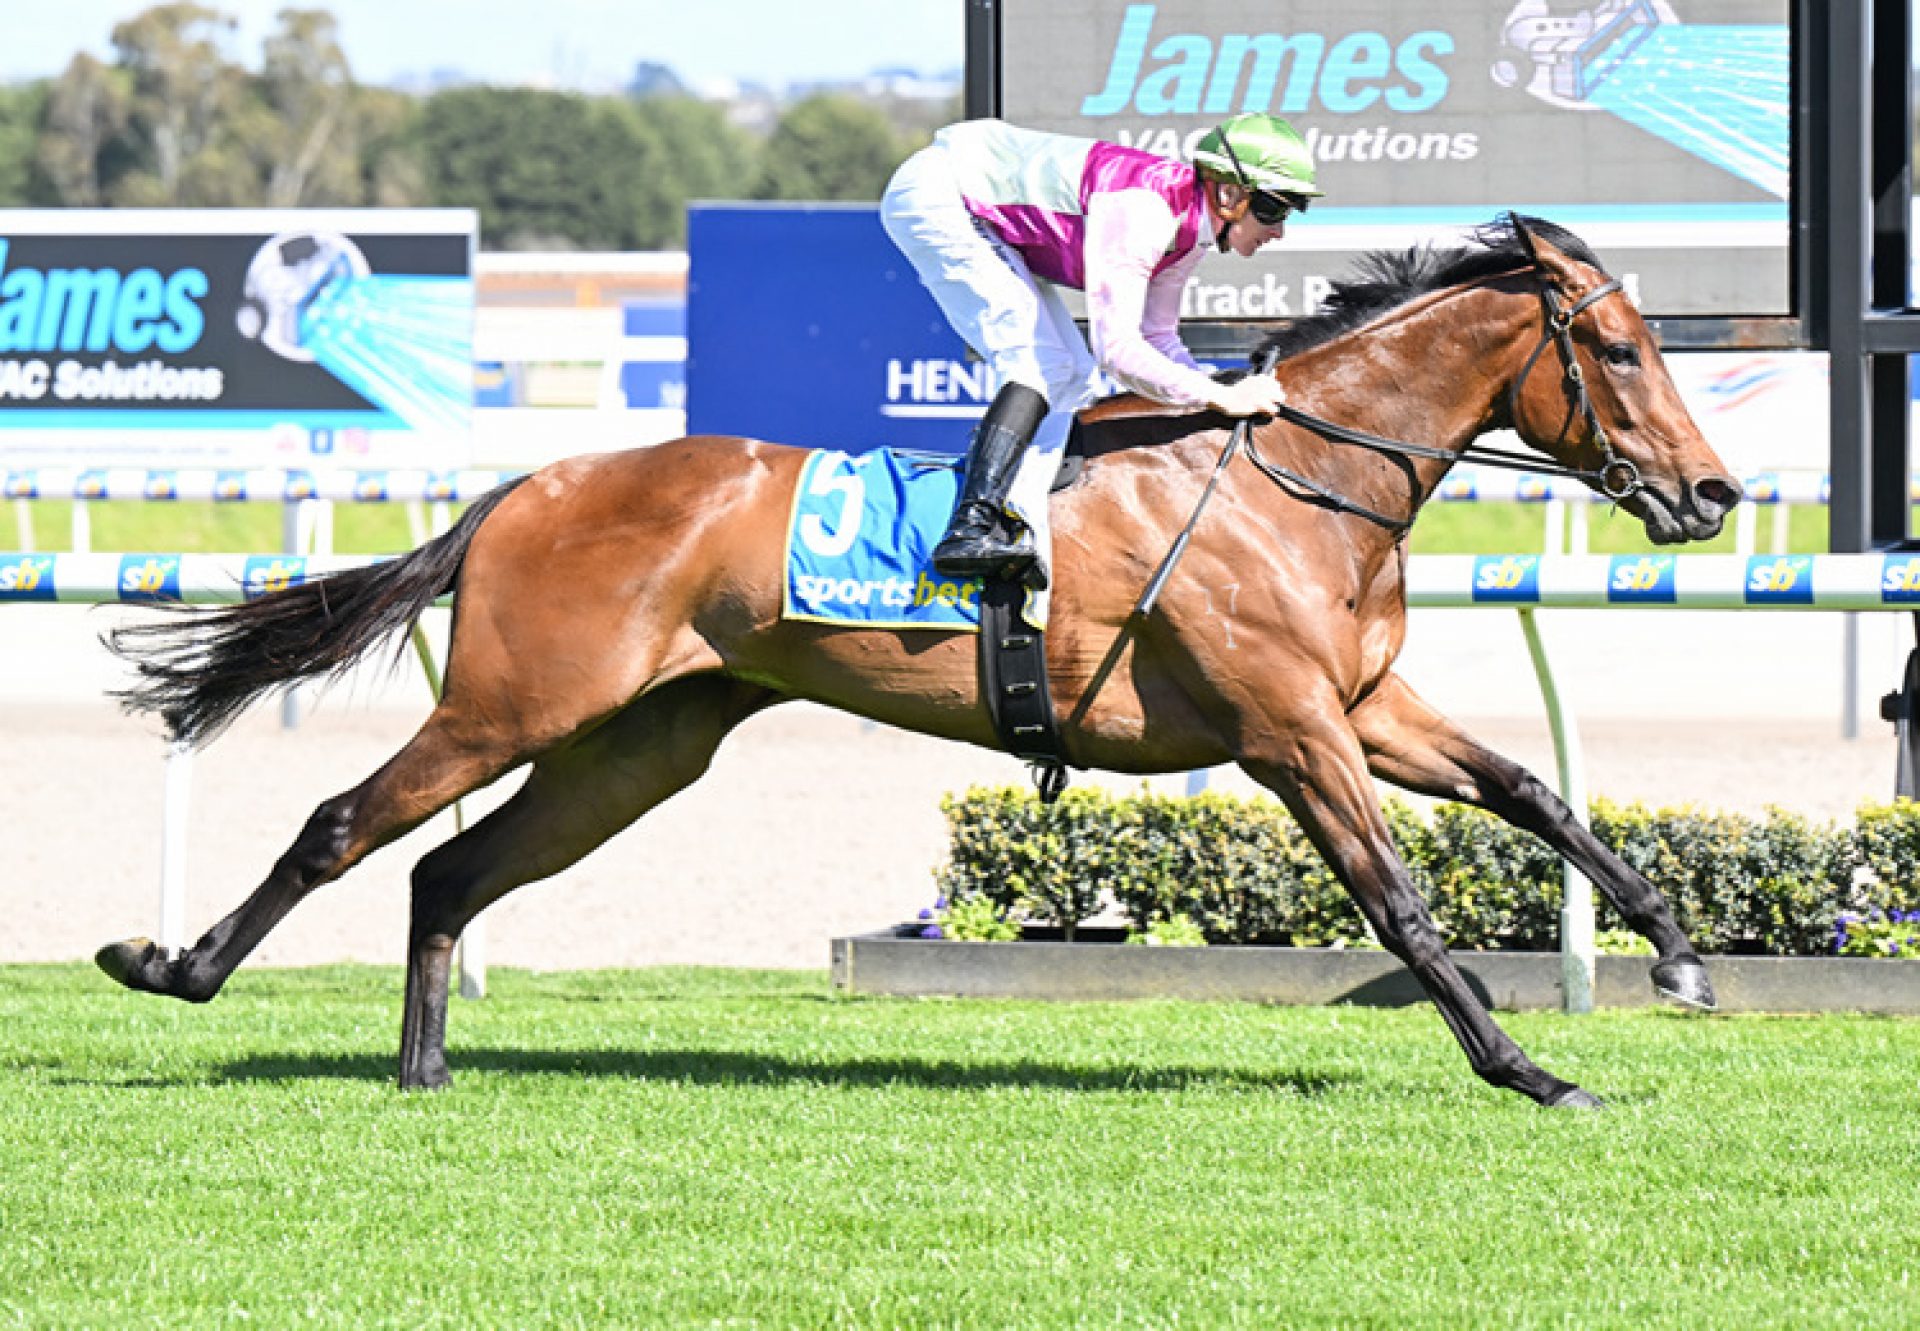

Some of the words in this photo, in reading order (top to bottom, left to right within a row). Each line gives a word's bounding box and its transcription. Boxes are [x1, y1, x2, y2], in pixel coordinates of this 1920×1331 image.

[1079, 3, 1456, 116] James
[1303, 126, 1481, 163] lutions
[0, 358, 50, 400] AC
[52, 358, 225, 401] Solutions
[801, 451, 873, 556] 5
[122, 558, 165, 592] sb
[797, 572, 977, 610] sportsbet
[1476, 557, 1523, 590] sb
[1612, 558, 1660, 592] sb
[1748, 558, 1797, 592] sb
